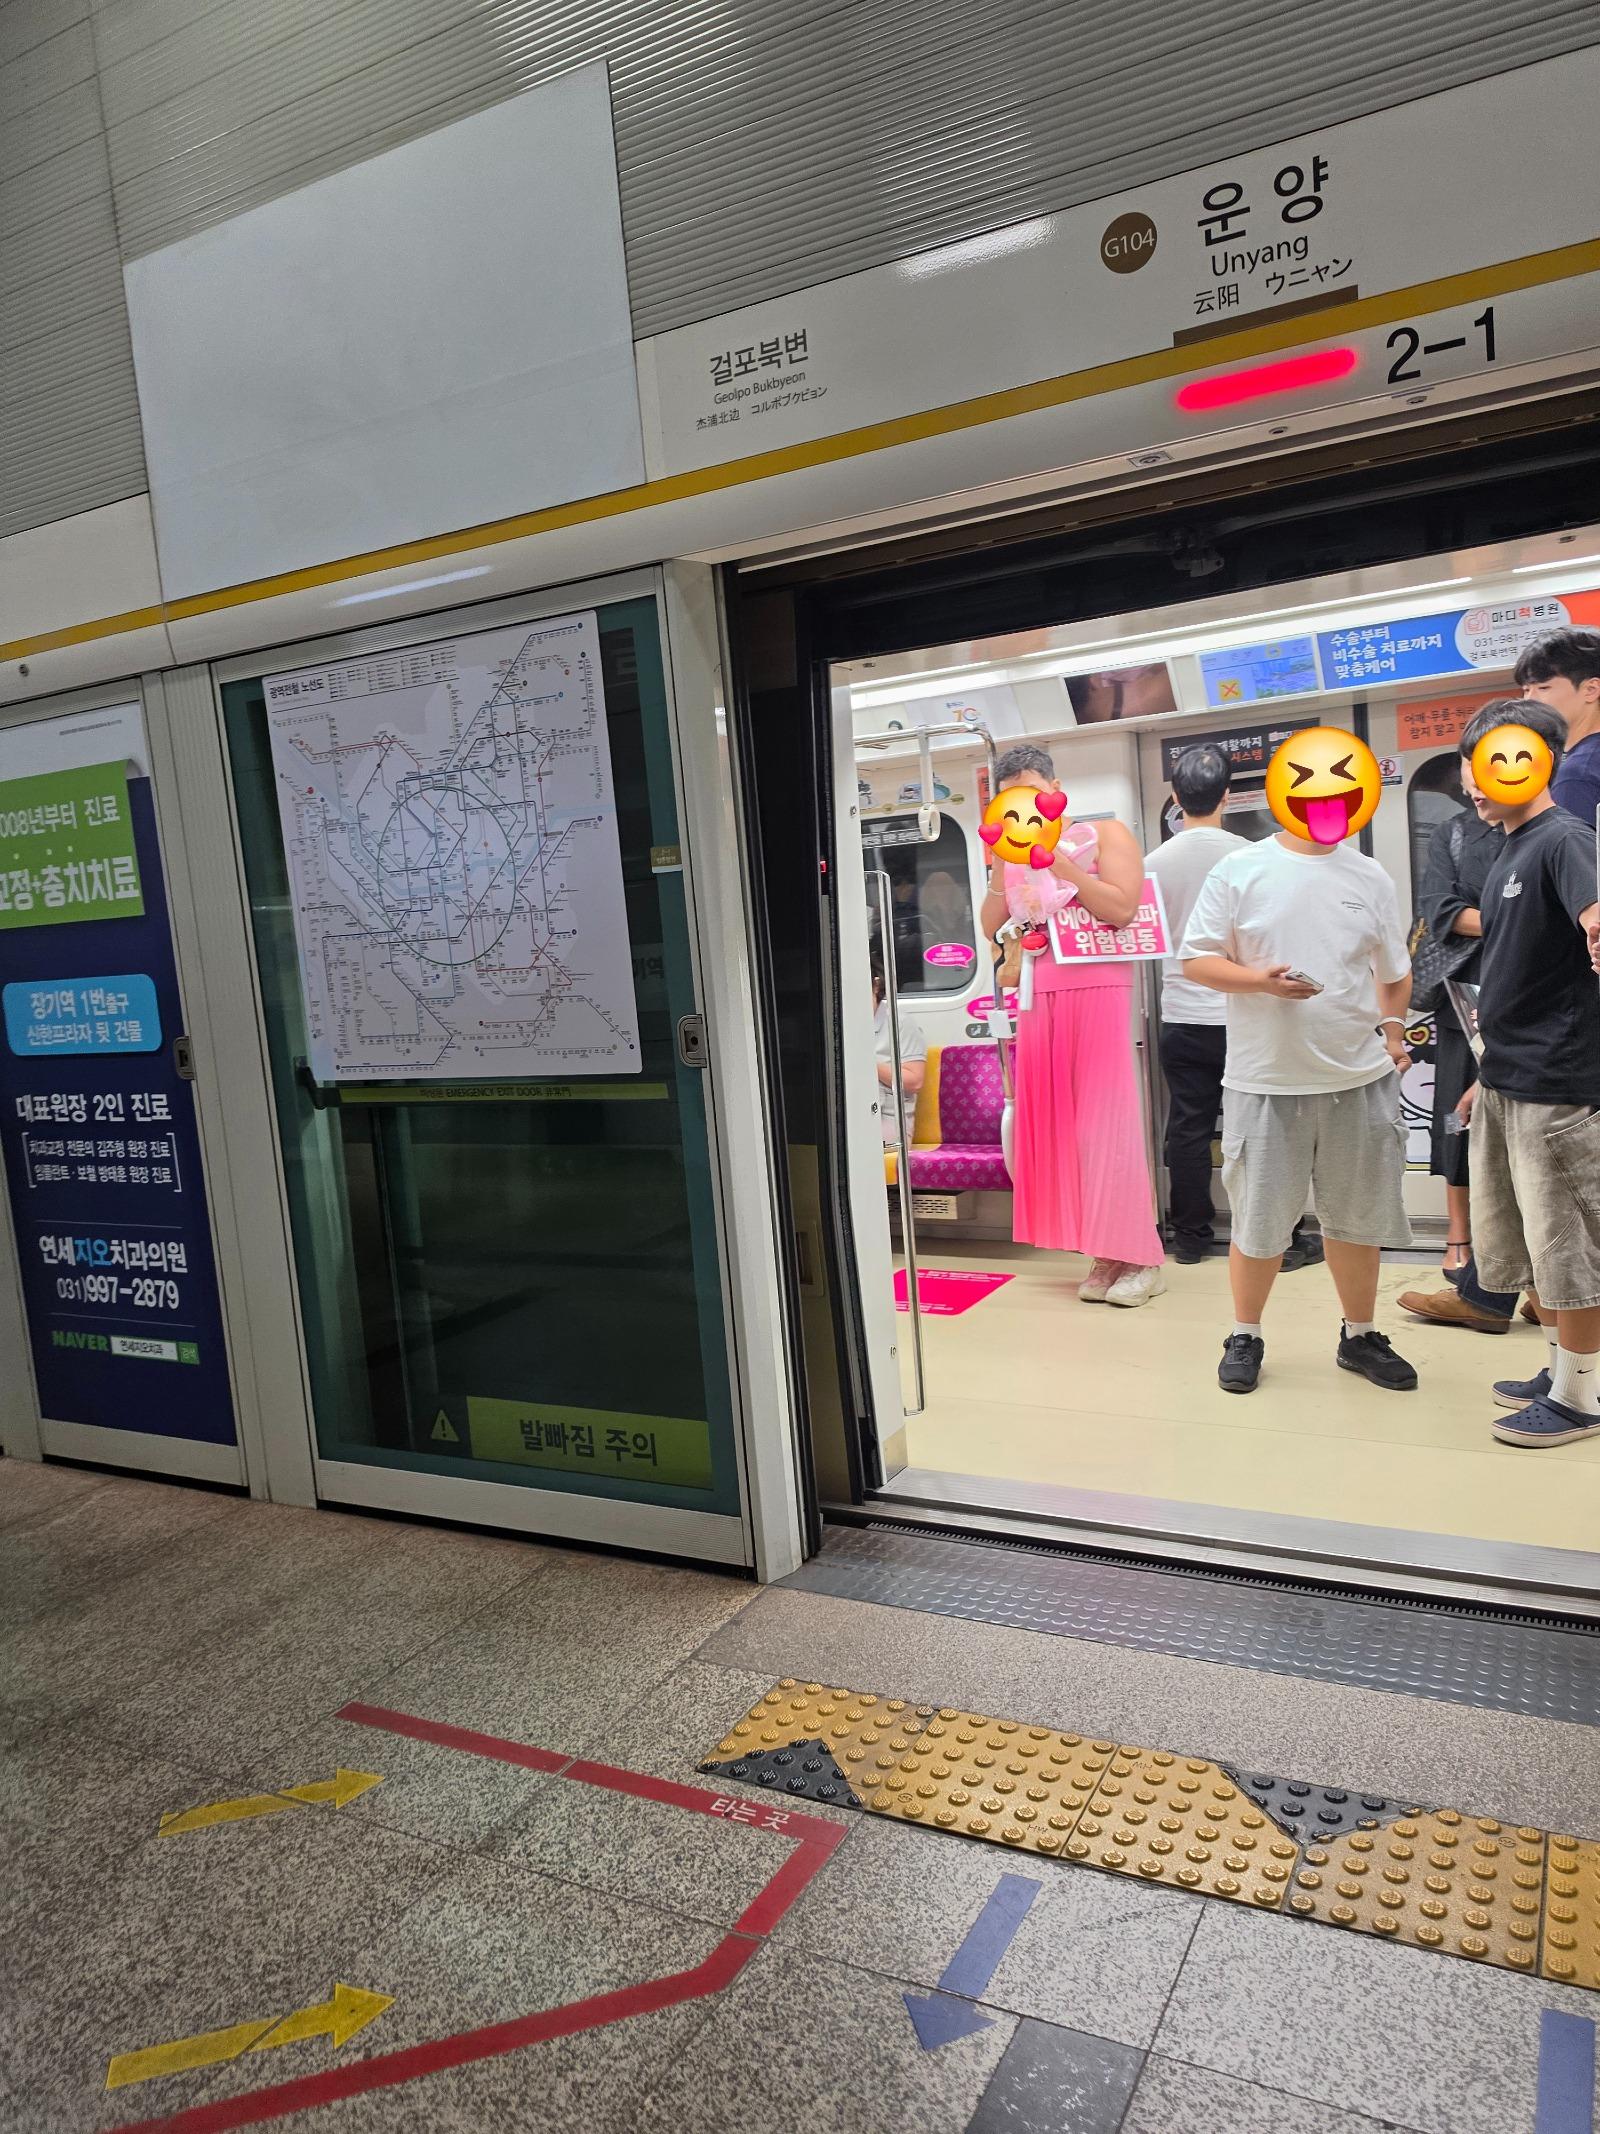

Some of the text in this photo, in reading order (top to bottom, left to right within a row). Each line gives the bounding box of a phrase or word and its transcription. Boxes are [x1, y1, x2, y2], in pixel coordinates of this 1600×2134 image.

[1104, 228, 1155, 258] G104
[1211, 236, 1309, 277] Unyang
[1193, 258, 1353, 315] 云阳 ウニャン
[709, 328, 809, 387] 걸포북변
[1386, 306, 1496, 385] 2-1
[713, 371, 806, 405] Geolpo Bukbyeon
[1329, 625, 1391, 647] 수술부터
[1331, 643, 1378, 662] 비수술
[1380, 633, 1443, 655] 치료까지
[1333, 657, 1396, 680] 맞춤케어
[83, 795, 121, 827] 진료
[1075, 928, 1158, 955] 위험행동
[29, 987, 130, 1020] 장기역 1번출구
[114, 1019, 143, 1043] 건물
[15, 1092, 173, 1123] 대표원장 2인 진료
[446, 1087, 496, 1098] EMERGENCY
[516, 1086, 543, 1097] DOOR
[127, 1140, 148, 1159] 원장
[149, 1140, 172, 1159] 진료
[128, 1165, 150, 1184] 원장
[151, 1166, 173, 1184] 진료
[38, 1234, 188, 1274] 연세지오치과의원
[56, 1273, 181, 1310] 031)997-2879
[51, 1330, 110, 1352] NAVER
[519, 1418, 658, 1466] 발빠짐 주의
[709, 1797, 791, 1831] 타는 곳
